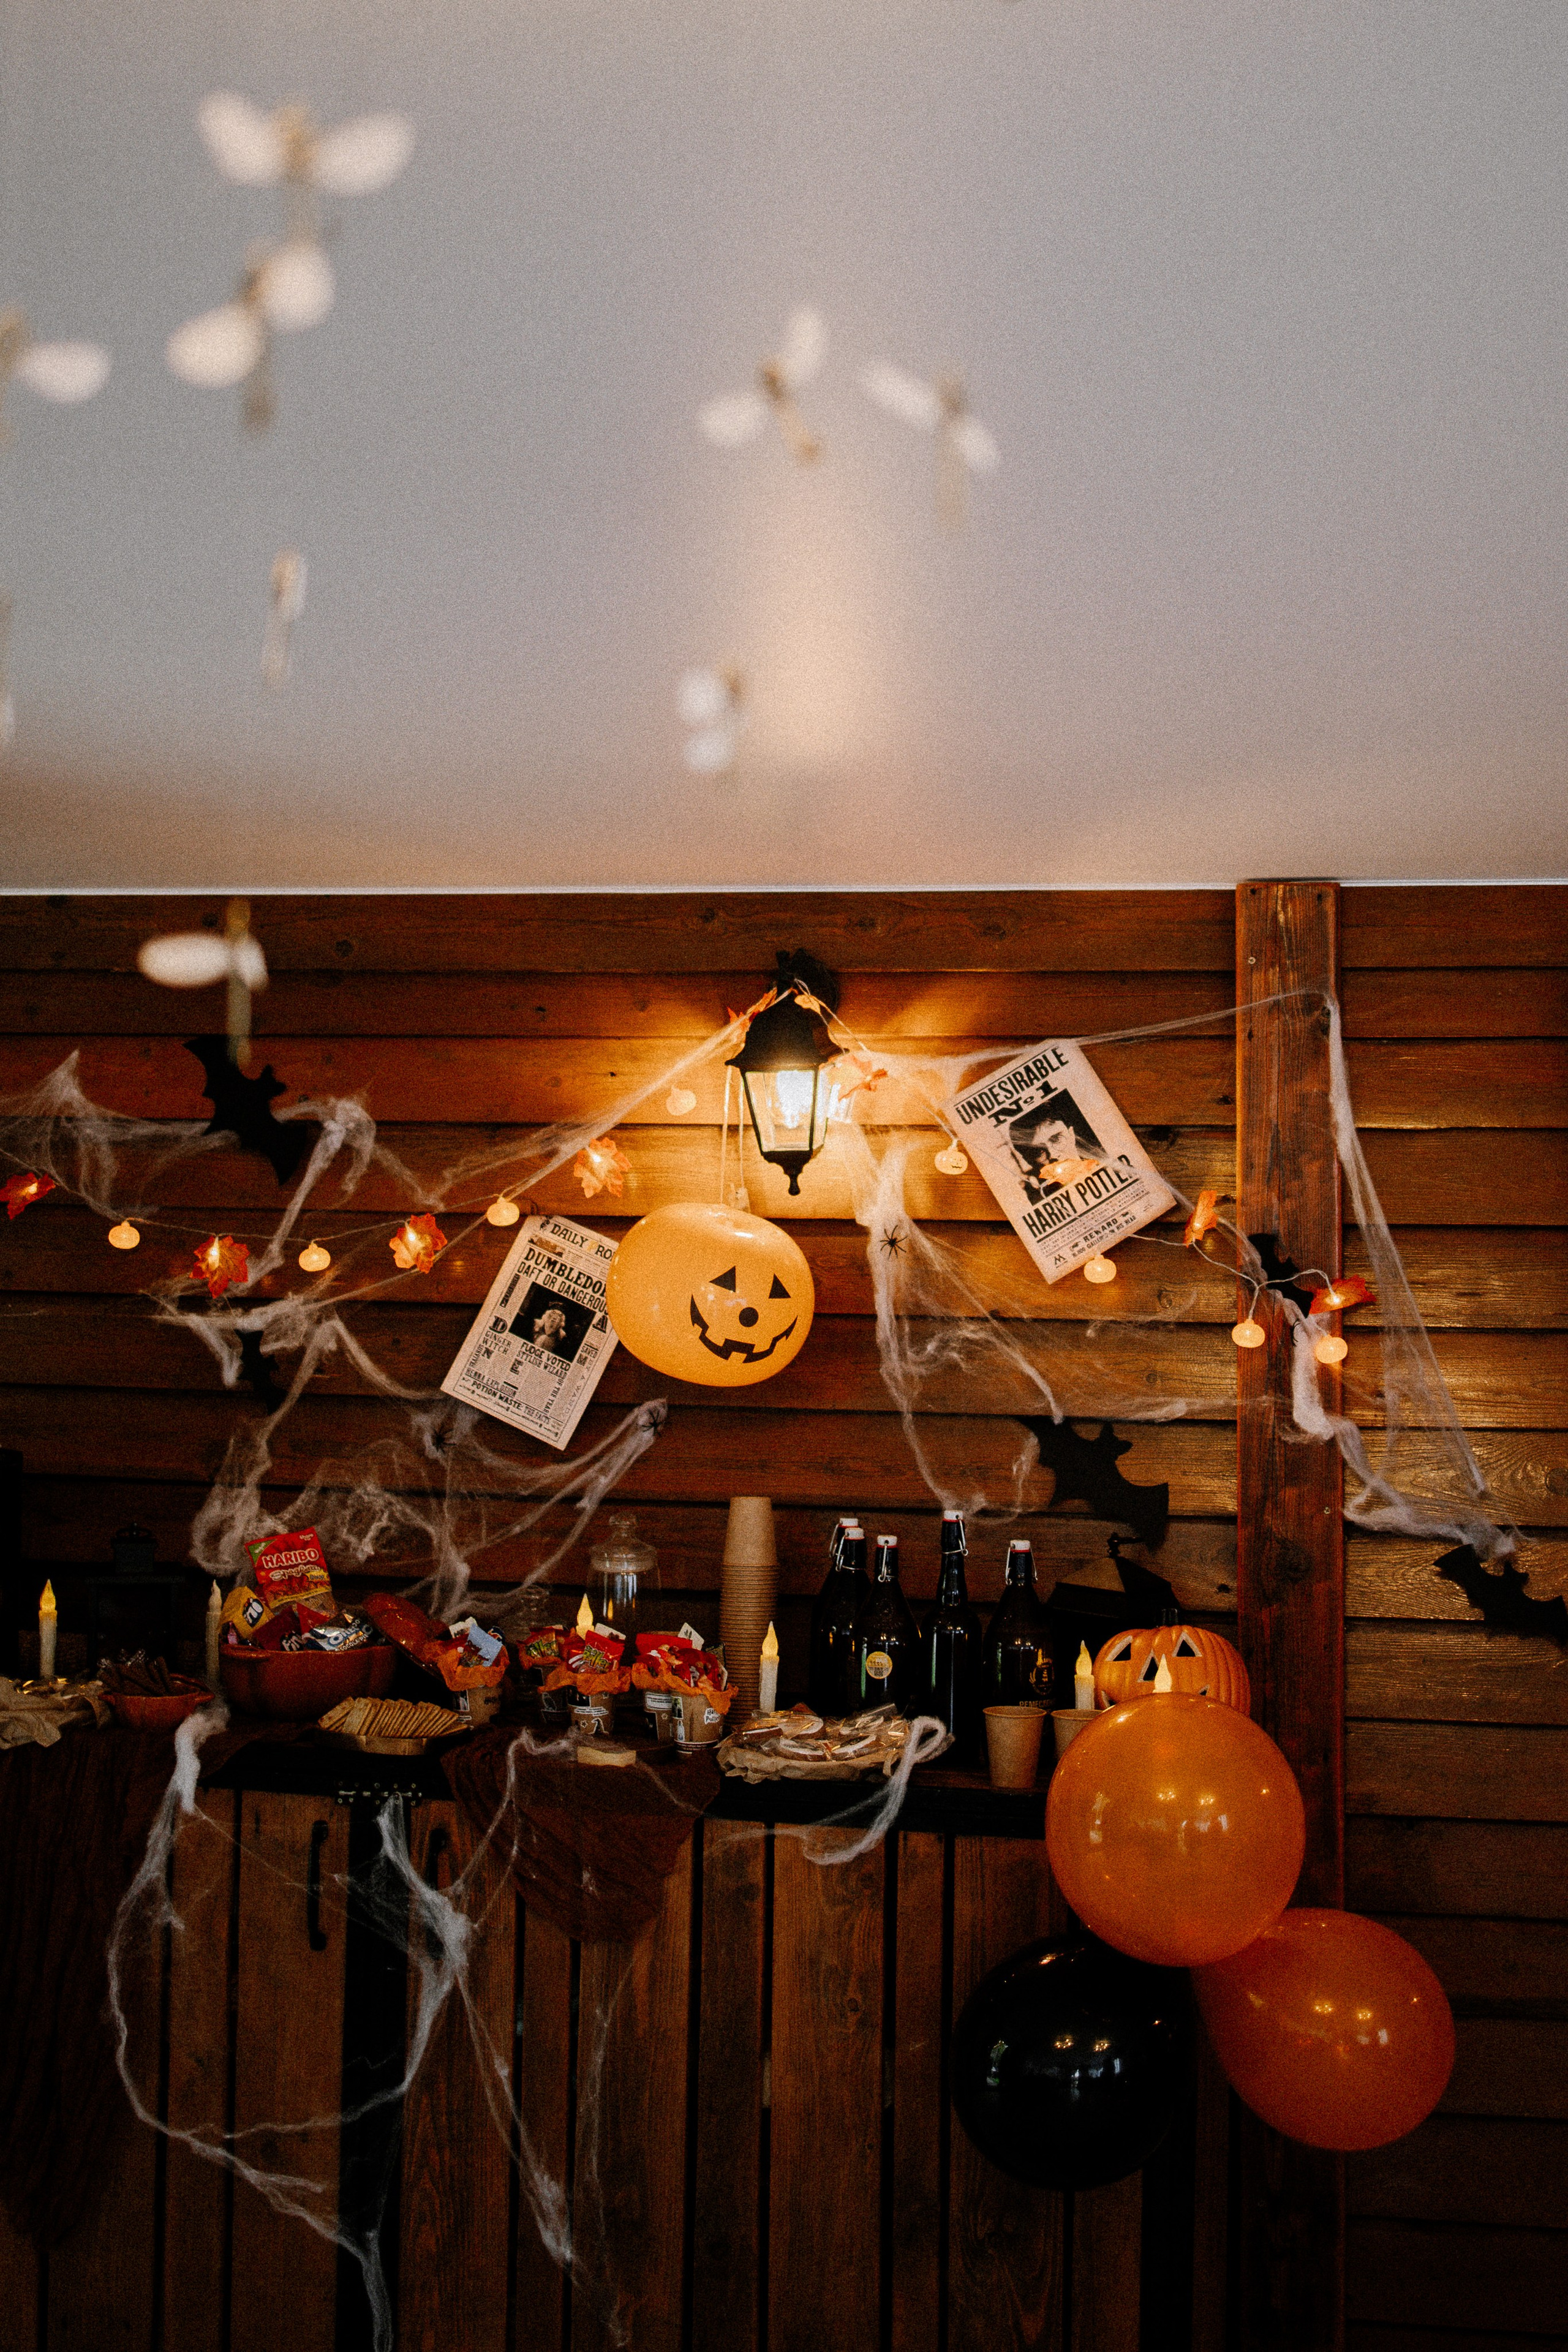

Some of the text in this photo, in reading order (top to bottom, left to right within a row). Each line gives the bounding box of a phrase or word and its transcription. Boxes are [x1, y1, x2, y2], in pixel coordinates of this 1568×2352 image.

[955, 1047, 1069, 1125] UNDESIRABLE
[1021, 1189, 1077, 1238] HARRY
[1074, 1153, 1137, 1206] POTTER
[1082, 1217, 1118, 1242] REWARD
[1123, 1215, 1136, 1225] HEAD
[549, 1222, 589, 1248] DAILY
[516, 1261, 543, 1281] DAFT
[542, 1273, 557, 1289] OR
[481, 1336, 509, 1355] WITCH
[484, 1330, 511, 1347] GINGER
[516, 1349, 543, 1368] STYLISH
[543, 1362, 567, 1380] WIZARD
[520, 1341, 571, 1371] FUDGE VOTED
[466, 1368, 485, 1381] HENNA
[470, 1380, 498, 1398] POTION
[550, 1385, 560, 1398] THE
[543, 1398, 554, 1413] YEAR
[262, 1548, 320, 1569] HARIBO
